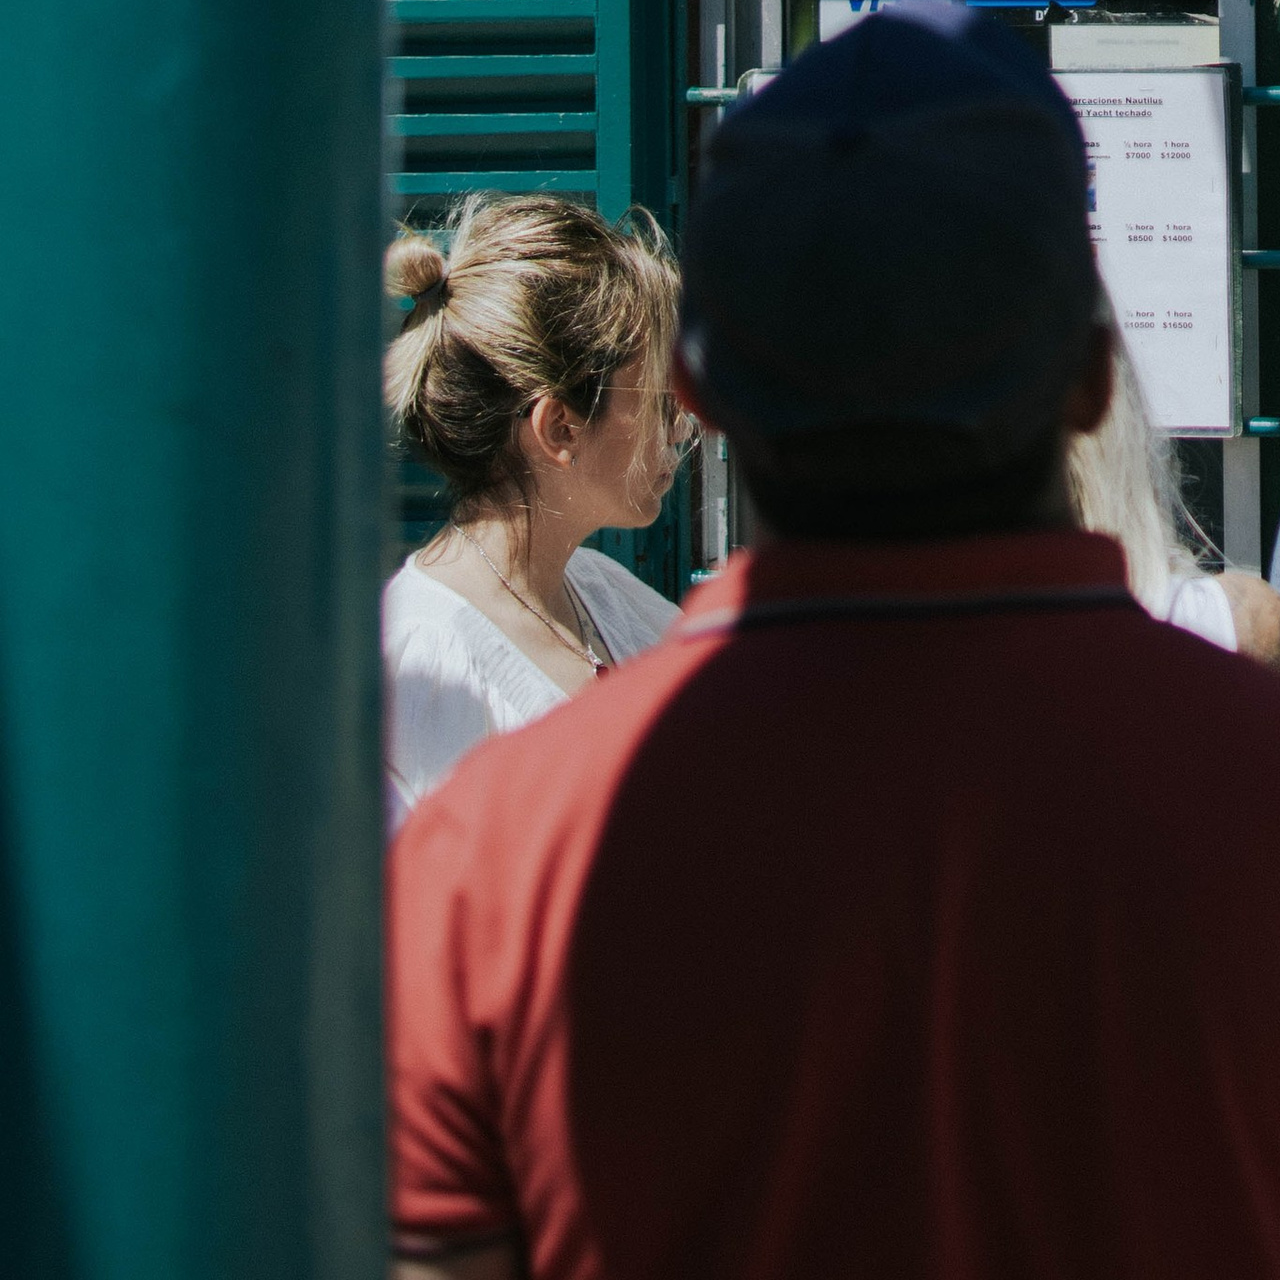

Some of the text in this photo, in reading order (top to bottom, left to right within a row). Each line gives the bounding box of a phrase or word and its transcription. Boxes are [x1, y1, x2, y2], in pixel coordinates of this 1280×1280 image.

[1125, 97, 1163, 105] Nautilus
[1087, 109, 1112, 117] Yacht
[1115, 109, 1152, 117] techado
[1126, 151, 1191, 160] $7000 $12000
[1128, 234, 1193, 242] $8500 $14000
[1162, 321, 1193, 329] $16500
